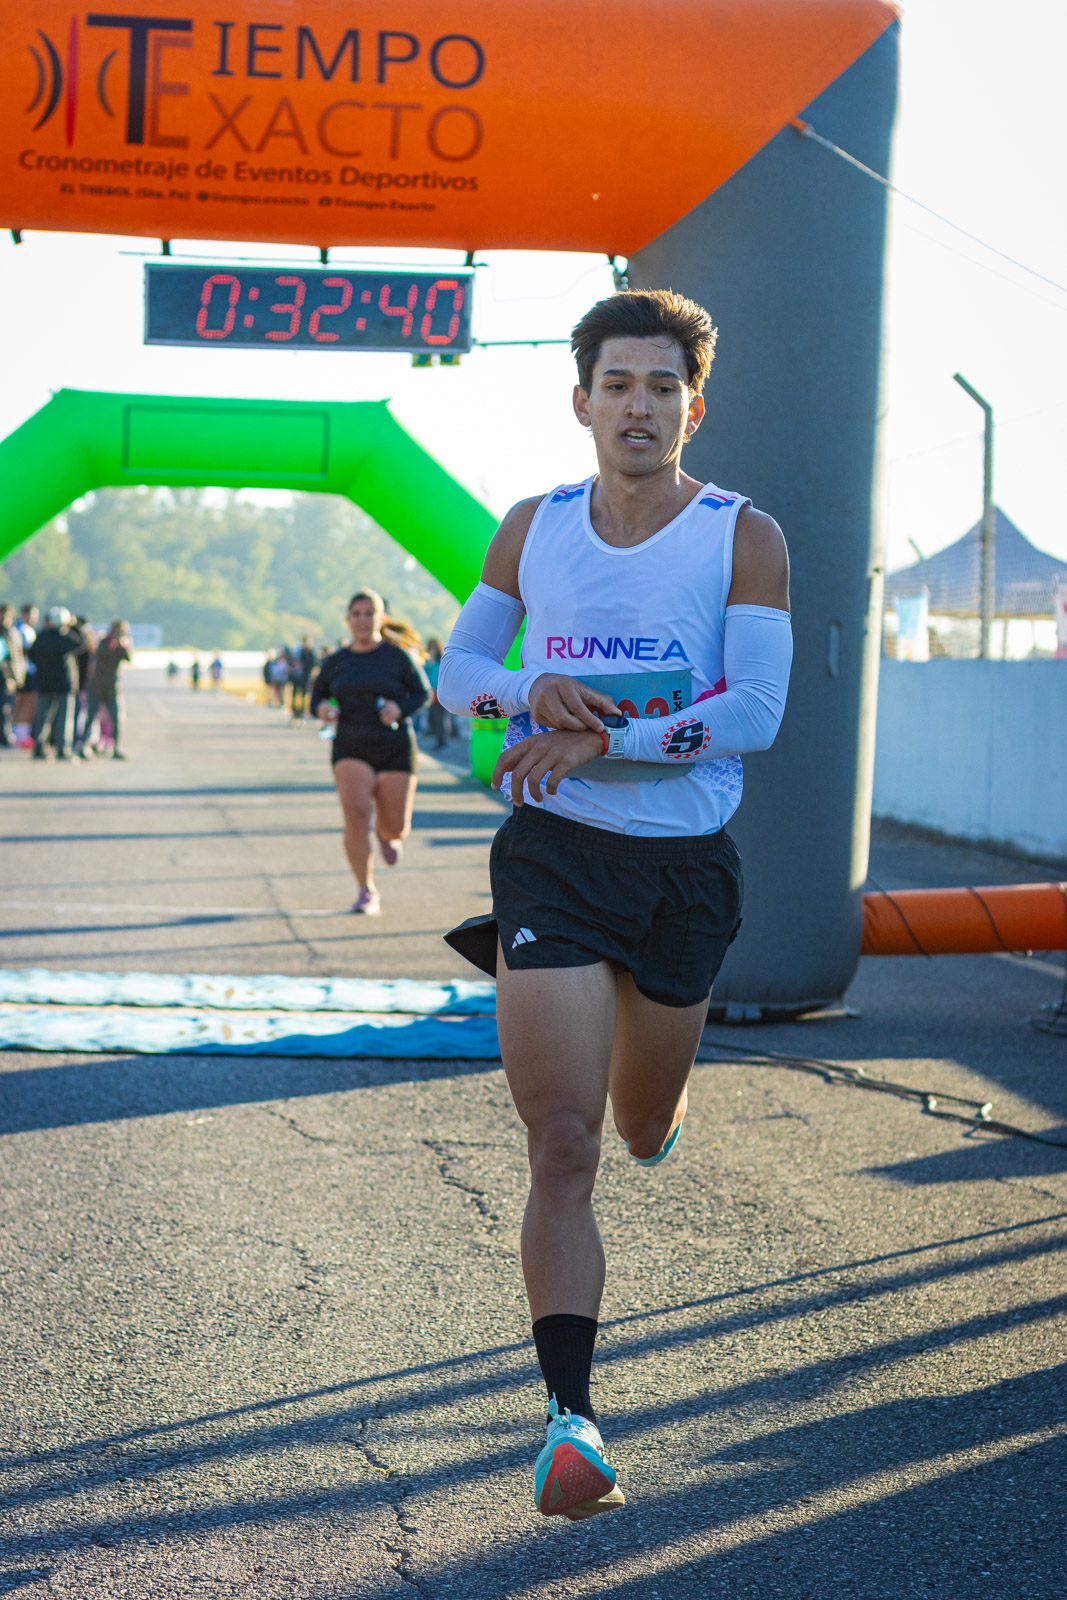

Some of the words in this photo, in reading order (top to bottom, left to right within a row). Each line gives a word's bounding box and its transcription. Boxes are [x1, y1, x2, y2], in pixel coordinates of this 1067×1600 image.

[86, 13, 487, 146] TIEMPO
[148, 34, 485, 163] EXACTO
[18, 149, 189, 181] Cronometraje
[194, 159, 228, 180] de
[233, 160, 333, 185] Eventos
[340, 165, 479, 191] Deportivos
[196, 274, 464, 345] 0:32:40
[546, 636, 690, 663] RUNNEA
